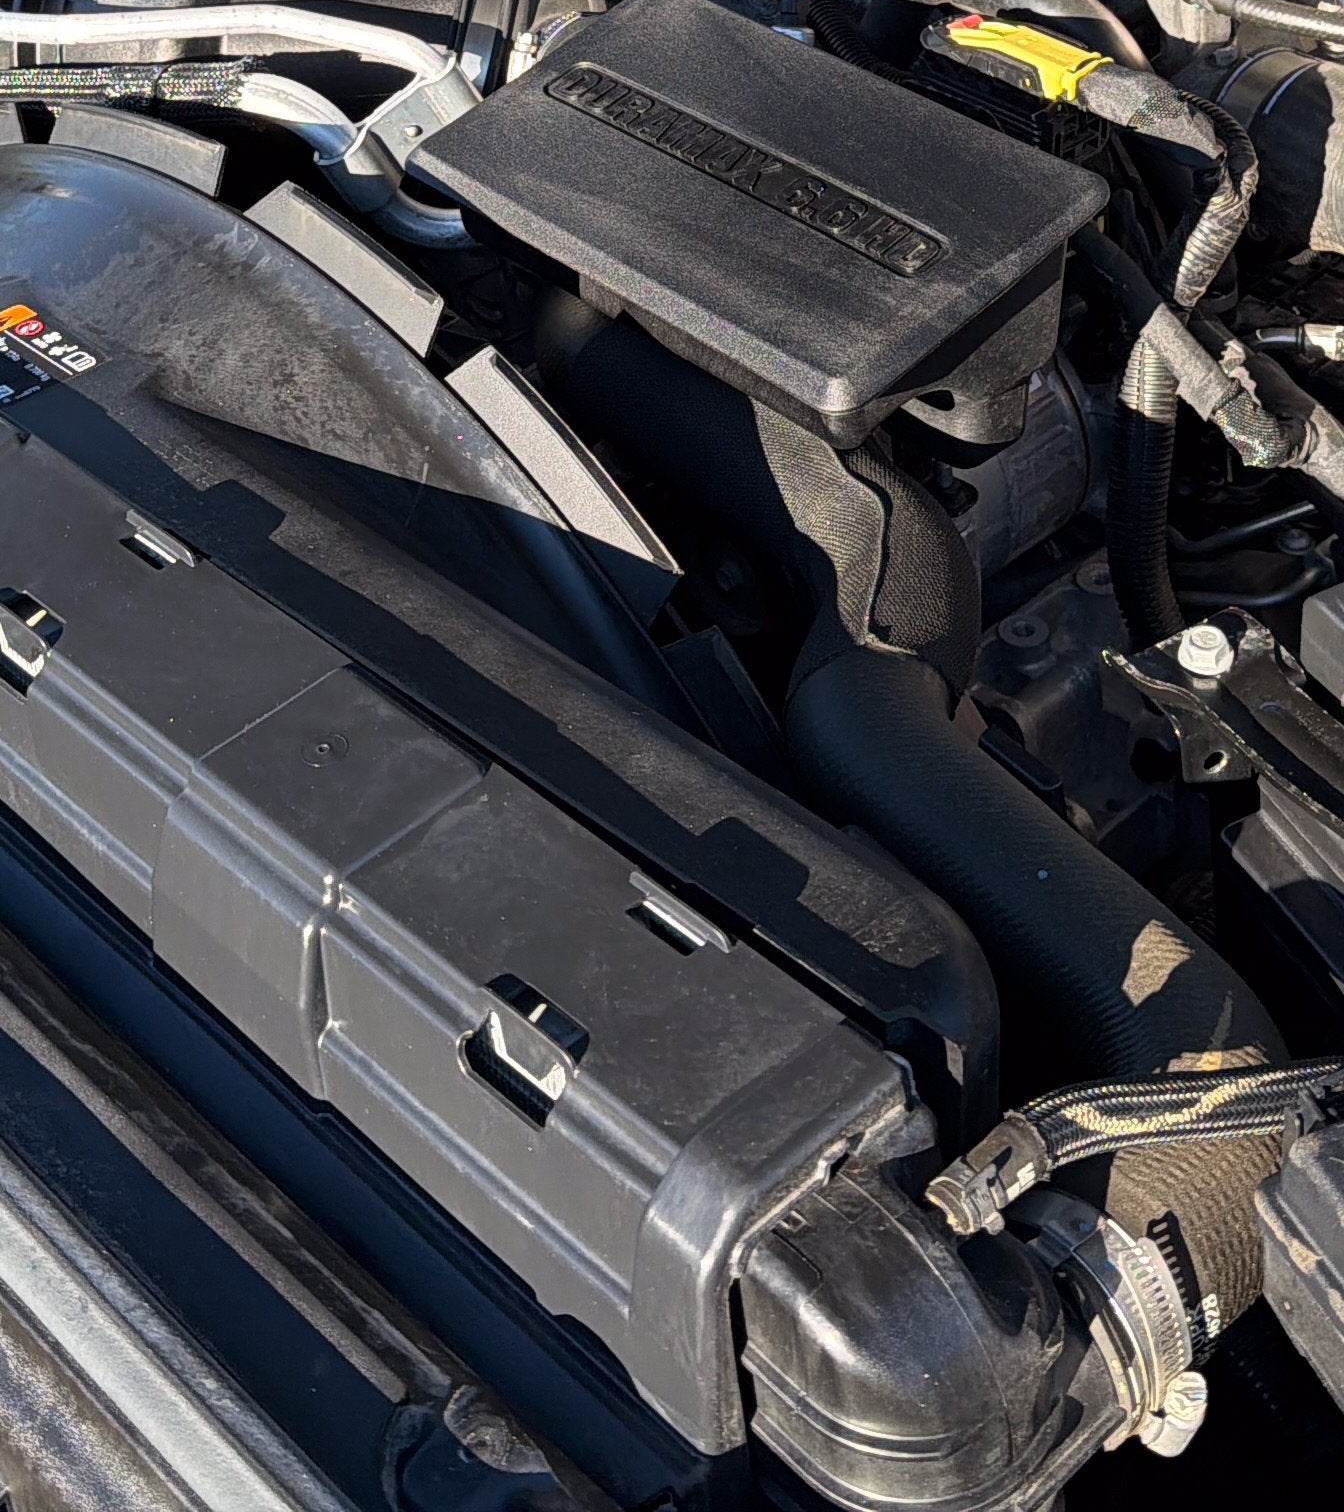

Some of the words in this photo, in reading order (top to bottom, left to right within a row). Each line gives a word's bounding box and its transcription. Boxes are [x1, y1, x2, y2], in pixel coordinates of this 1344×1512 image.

[565, 67, 784, 191] DURAMAX
[786, 175, 868, 234] 6.6
[862, 217, 940, 274] HD
